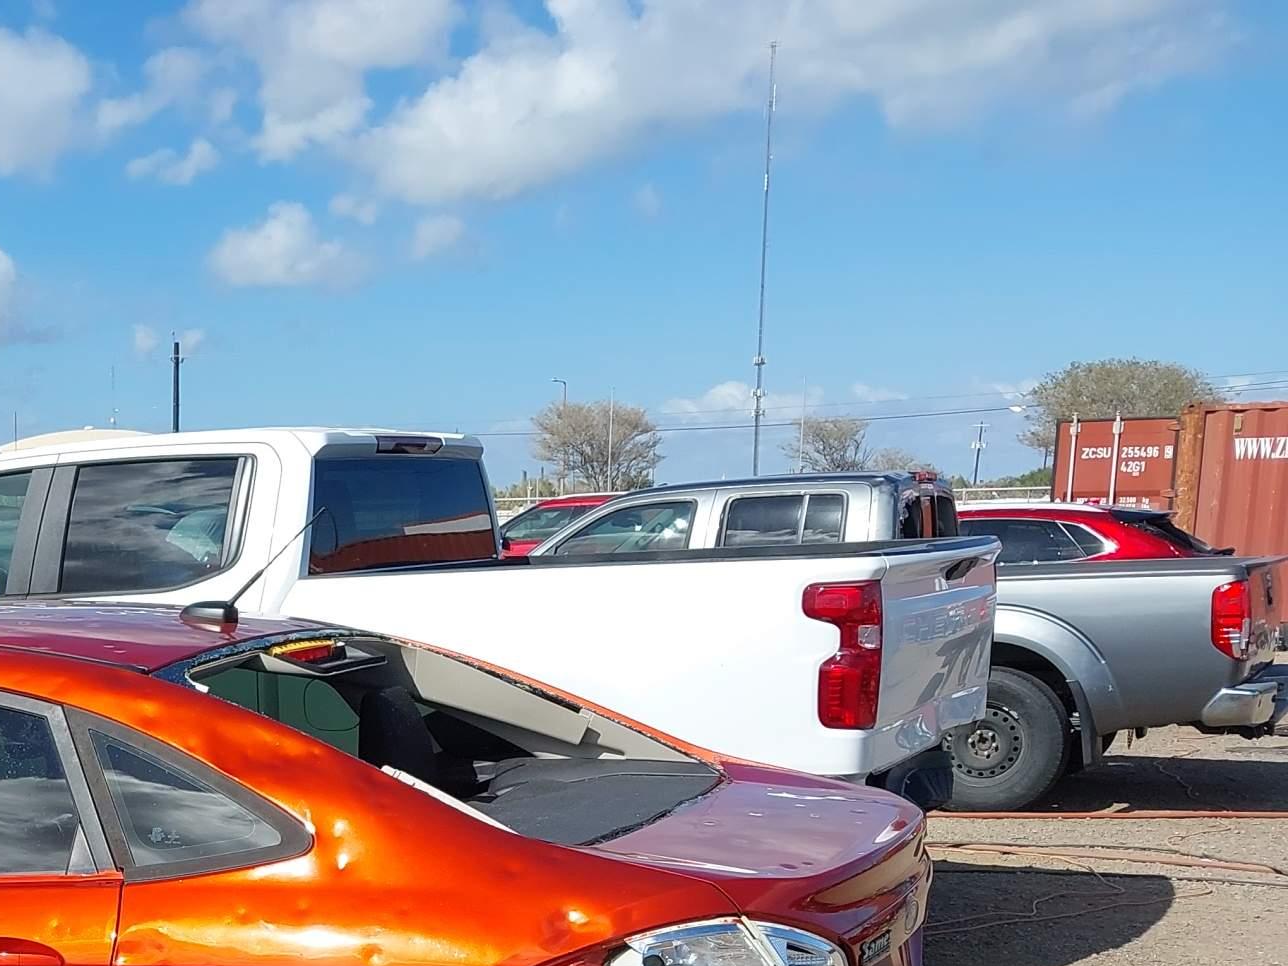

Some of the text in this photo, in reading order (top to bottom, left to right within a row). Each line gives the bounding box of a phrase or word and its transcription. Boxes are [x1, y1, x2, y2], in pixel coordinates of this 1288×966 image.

[1081, 447, 1112, 459] ZCSU
[1121, 446, 1159, 458] 255496
[1234, 437, 1288, 460] WWW.Z
[1120, 461, 1146, 473] 42G1
